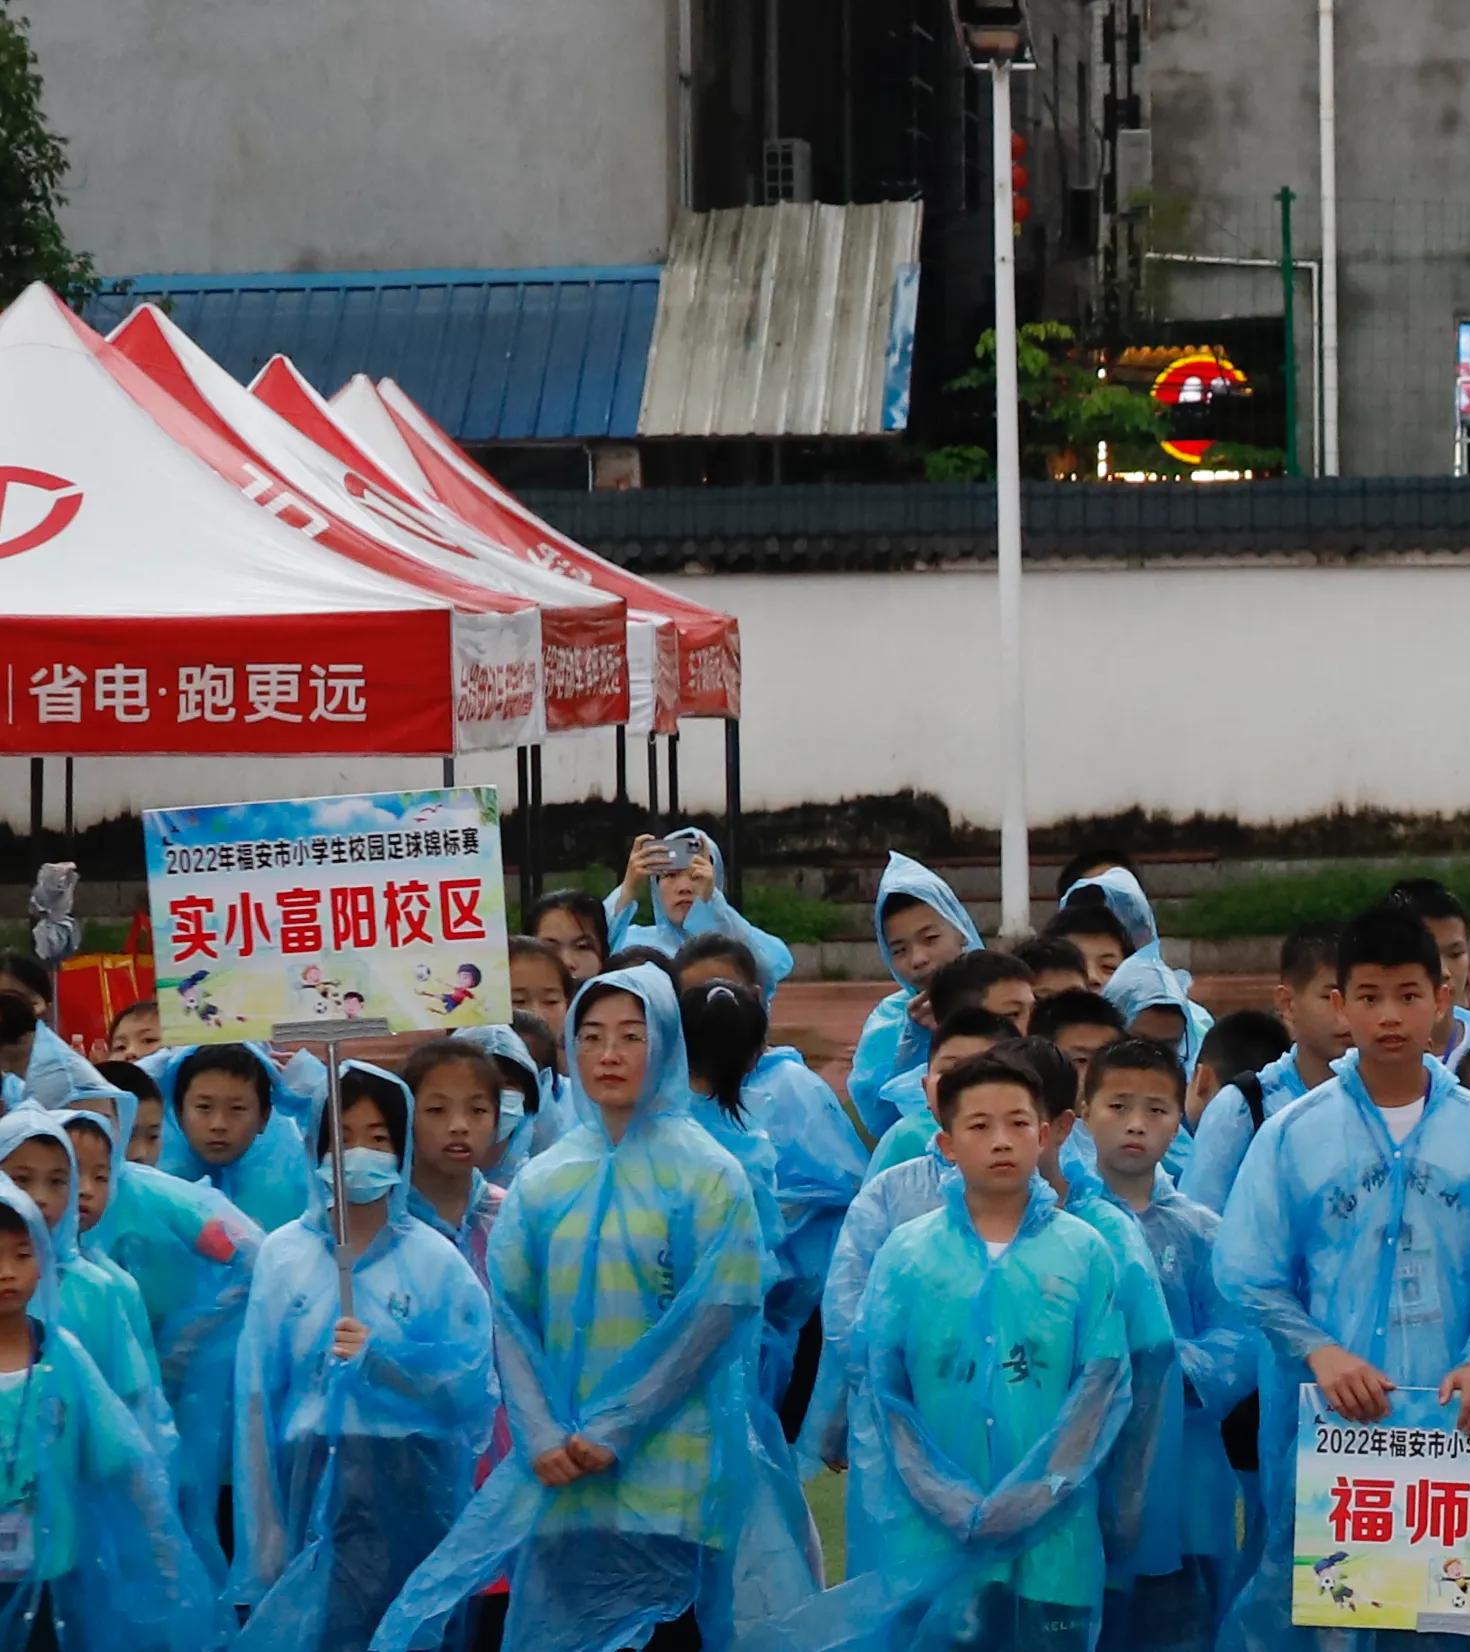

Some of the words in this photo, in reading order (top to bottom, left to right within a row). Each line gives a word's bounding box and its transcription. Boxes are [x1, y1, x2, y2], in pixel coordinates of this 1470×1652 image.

[165, 827, 480, 876] 2022年福安市小学生校园足球锦标赛
[168, 878, 487, 962] 实小富阳校区
